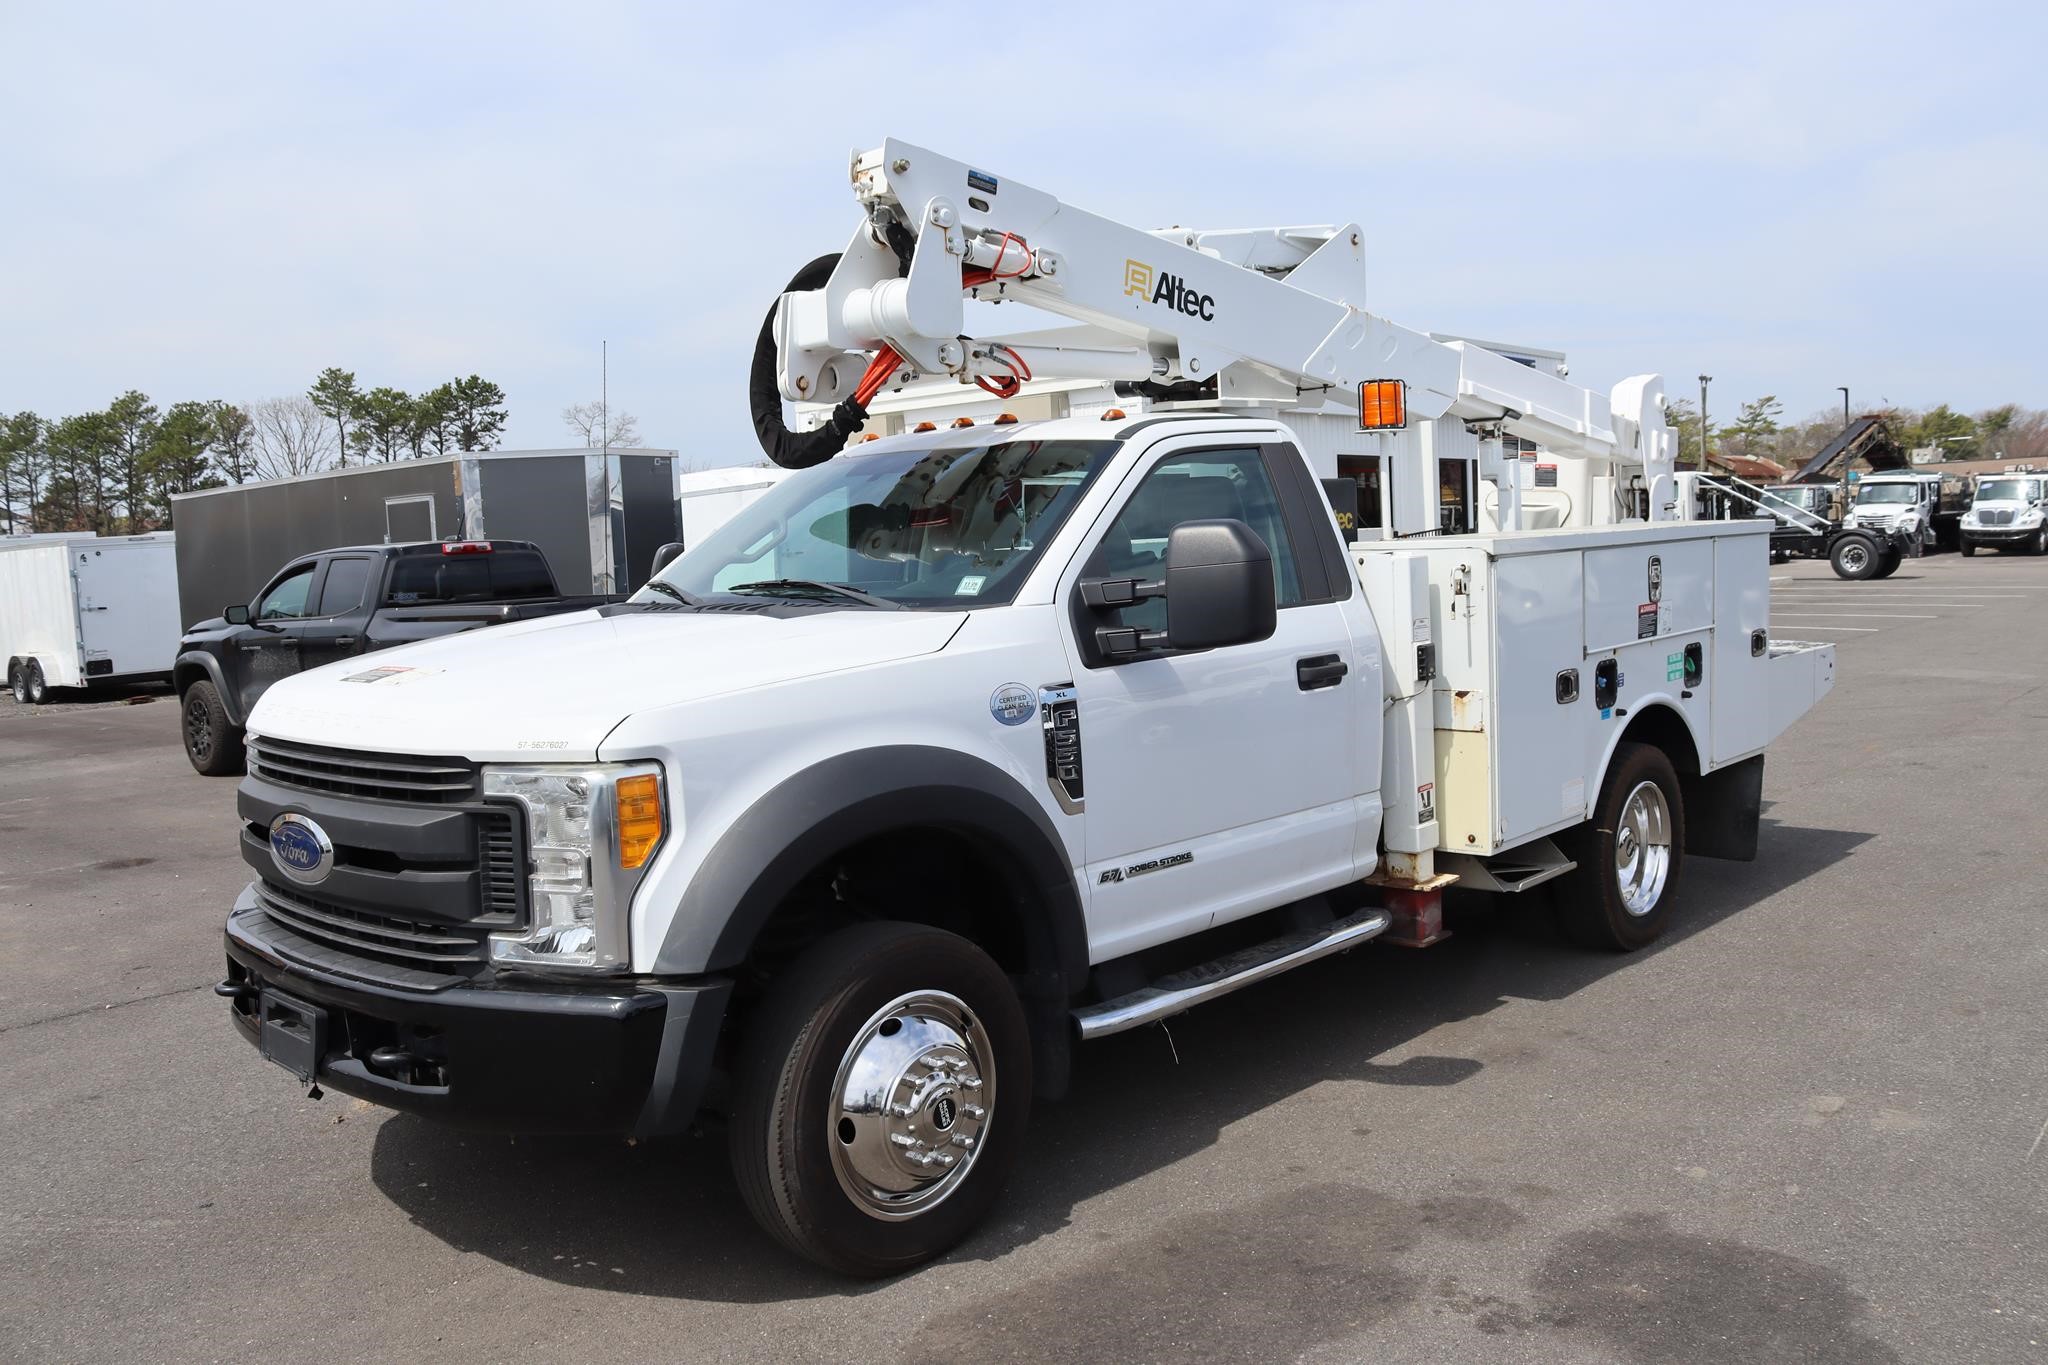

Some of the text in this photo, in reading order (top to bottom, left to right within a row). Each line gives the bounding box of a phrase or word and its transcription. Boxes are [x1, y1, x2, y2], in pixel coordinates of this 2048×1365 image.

[1152, 271, 1215, 322] Altec
[998, 694, 1027, 704] CERTIFIED
[998, 700, 1031, 711] CLEAN IDLE
[276, 830, 311, 865] Ford
[1128, 860, 1159, 875] POWER
[1159, 851, 1193, 866] STROKE
[942, 1099, 951, 1125] PACIFIC
